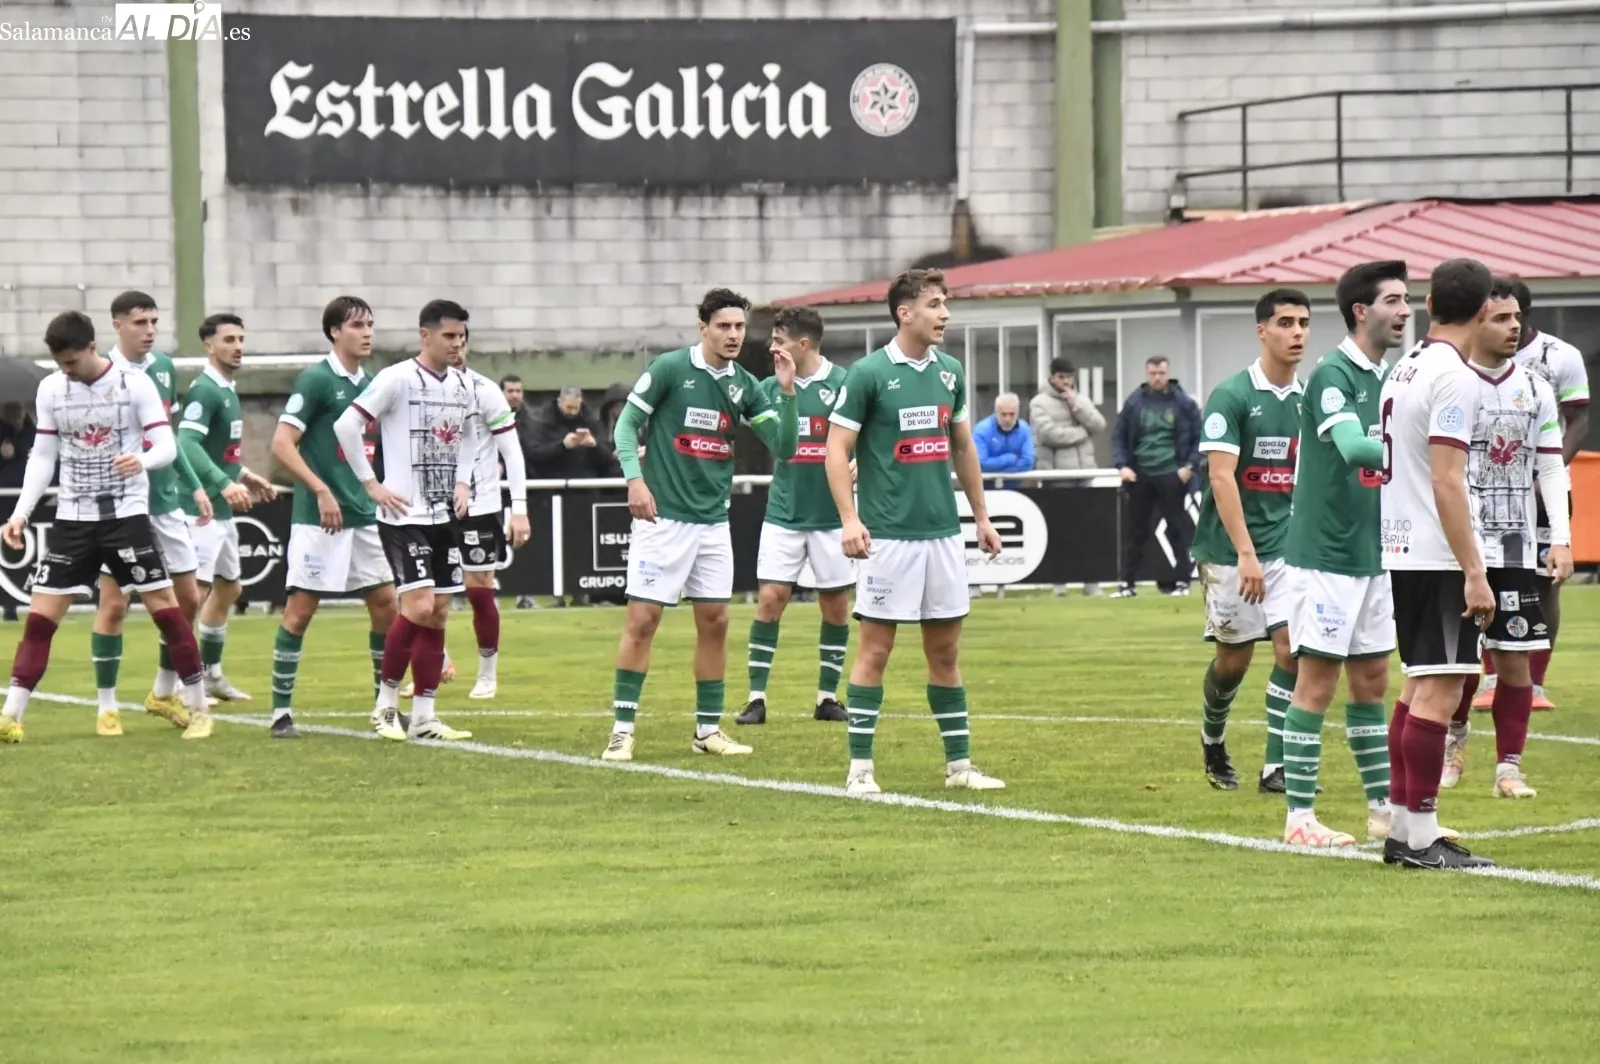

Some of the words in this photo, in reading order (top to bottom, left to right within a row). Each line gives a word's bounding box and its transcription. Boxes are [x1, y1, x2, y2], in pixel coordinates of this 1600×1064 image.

[264, 61, 557, 140] Estrella
[571, 61, 832, 140] Galicia
[689, 411, 717, 420] CONCELLO
[902, 410, 935, 419] CONCELLO
[907, 419, 917, 427] DE
[415, 559, 427, 578] 5
[579, 576, 626, 588] GRUPO
